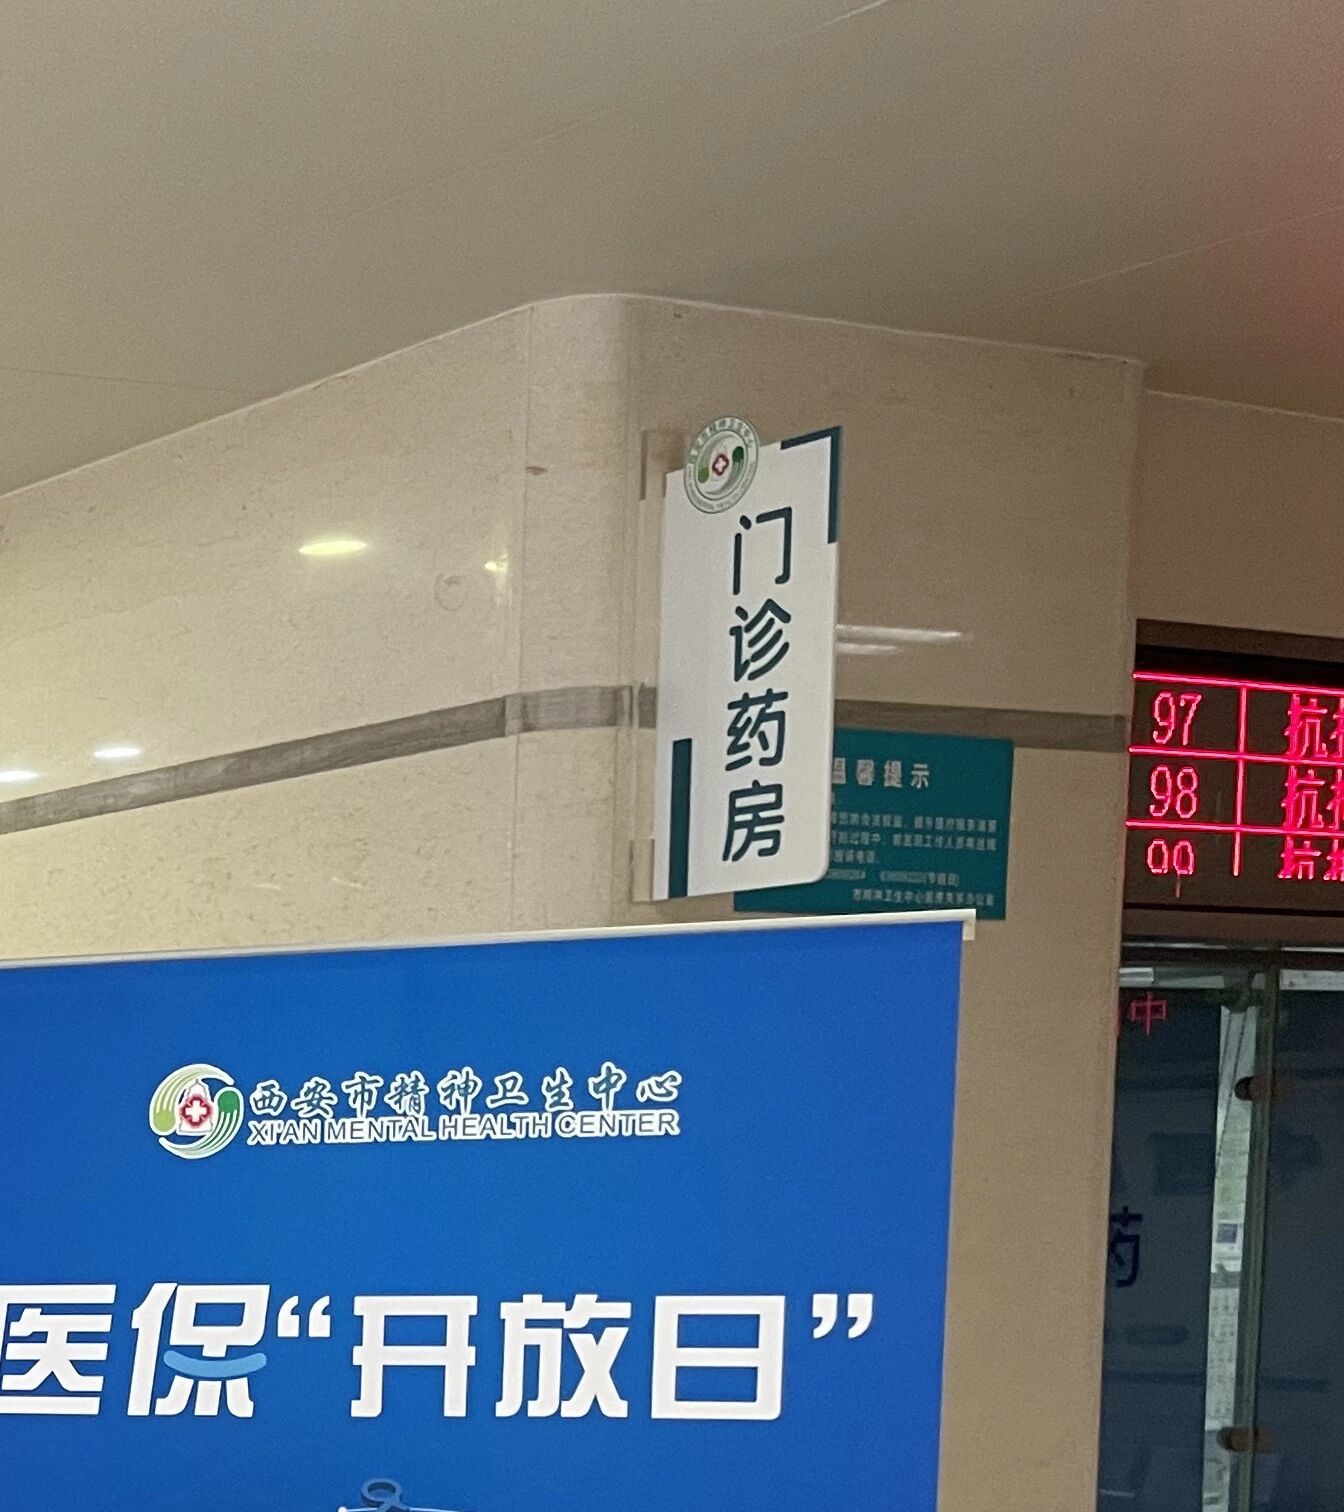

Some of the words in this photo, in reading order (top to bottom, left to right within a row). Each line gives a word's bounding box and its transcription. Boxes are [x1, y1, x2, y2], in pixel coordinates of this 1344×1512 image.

[721, 506, 793, 862] 门诊药房
[1153, 692, 1202, 746] 97
[1150, 766, 1198, 819] 98
[249, 1061, 684, 1118] 西安市精神卫生中心
[326, 1116, 436, 1144] MENTAL
[441, 1113, 549, 1141] HEALTH
[558, 1109, 680, 1137] CENTER
